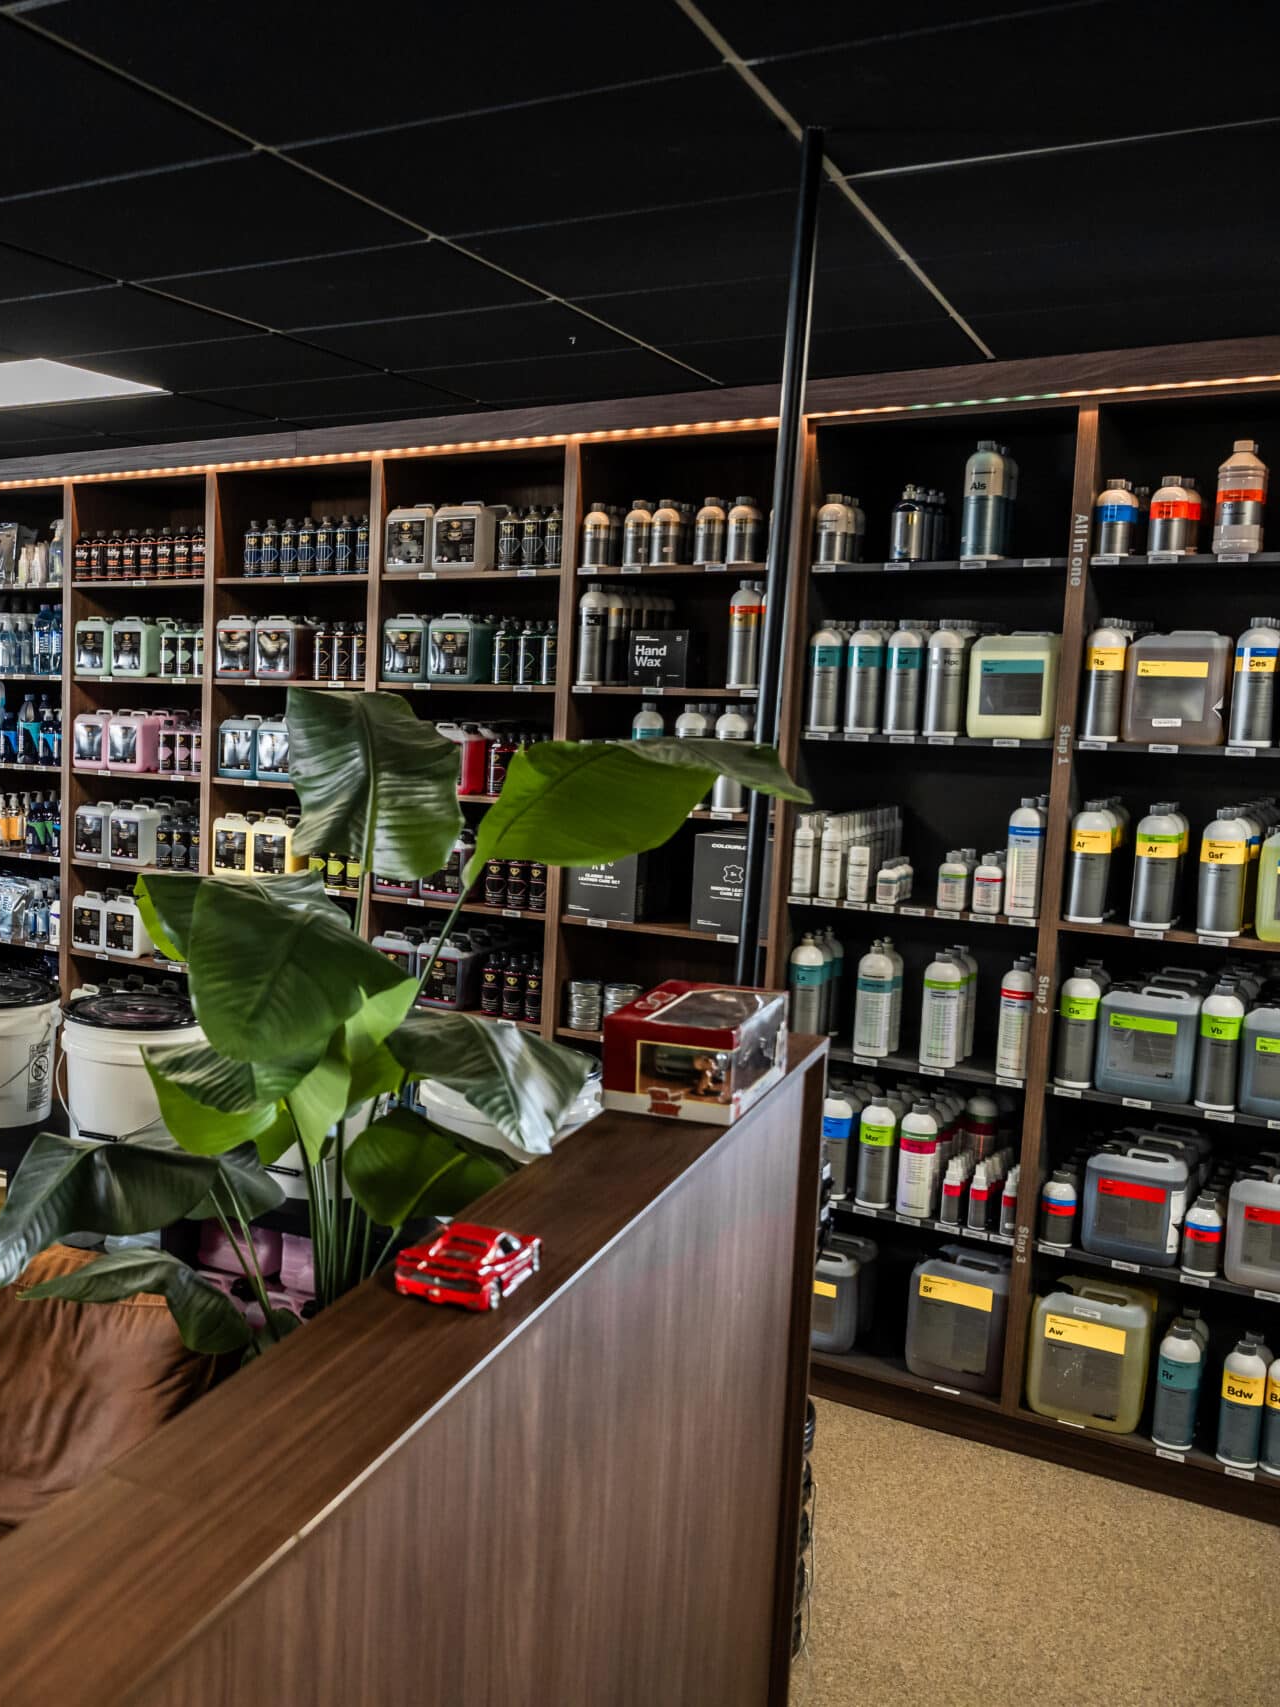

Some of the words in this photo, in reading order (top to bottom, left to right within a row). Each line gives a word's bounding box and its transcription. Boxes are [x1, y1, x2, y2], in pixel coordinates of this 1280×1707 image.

[970, 481, 987, 491] Als
[1074, 513, 1089, 534] All
[1073, 538, 1088, 553] in
[1070, 559, 1084, 587] one
[634, 644, 667, 657] Hand
[634, 656, 661, 668] Wax
[1248, 659, 1267, 668] Ces
[1057, 724, 1071, 755] Stap
[1208, 851, 1223, 860] Gsf
[1035, 974, 1050, 1002] Stap
[1036, 1003, 1049, 1015] 2
[1210, 1026, 1223, 1035] Vb
[1015, 1226, 1030, 1254] Stap
[1015, 1254, 1026, 1264] 3
[1048, 1326, 1064, 1337] Aw
[1226, 1385, 1254, 1400] Bdw
